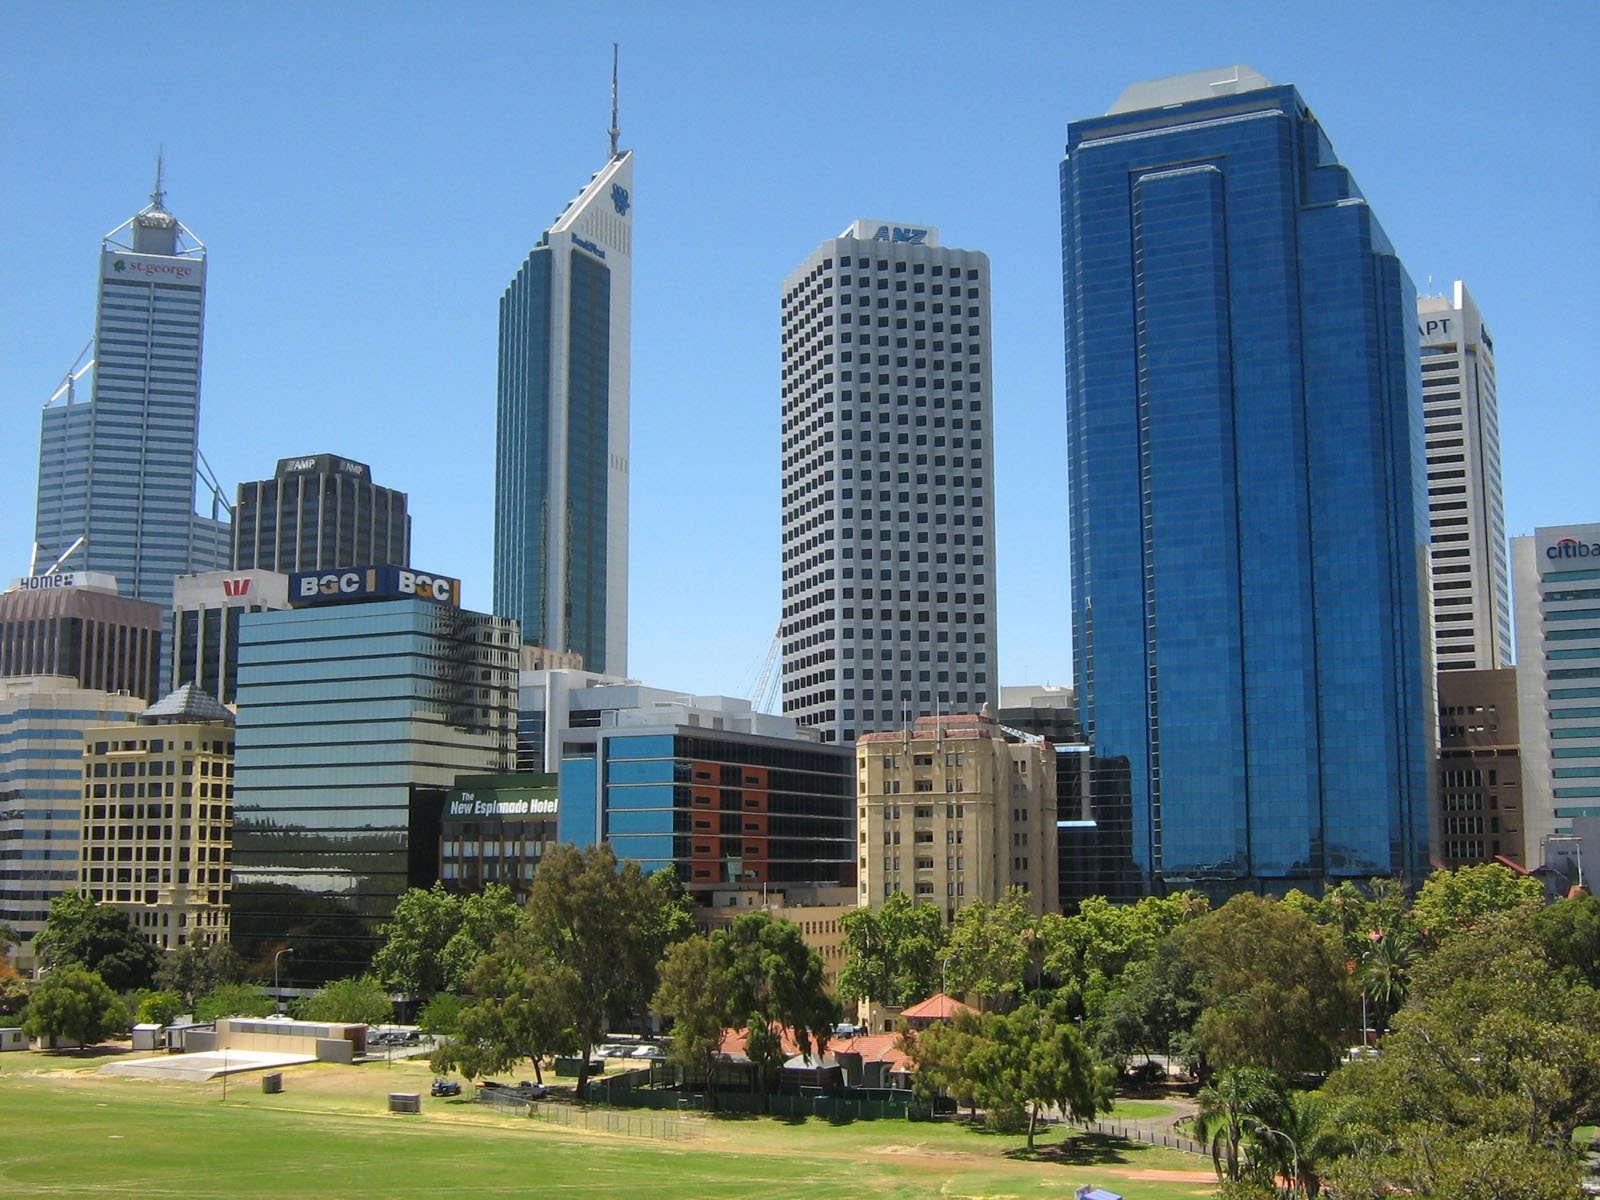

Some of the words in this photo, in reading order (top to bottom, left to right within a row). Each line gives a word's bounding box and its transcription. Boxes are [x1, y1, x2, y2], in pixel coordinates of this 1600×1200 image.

[872, 226, 928, 246] ANZ
[294, 459, 316, 470] AMP
[301, 572, 360, 596] BGC
[399, 570, 450, 601] BGC
[461, 792, 475, 801] The
[450, 801, 473, 815] New
[474, 800, 529, 817] Esplanade
[530, 798, 559, 814] Hotel
